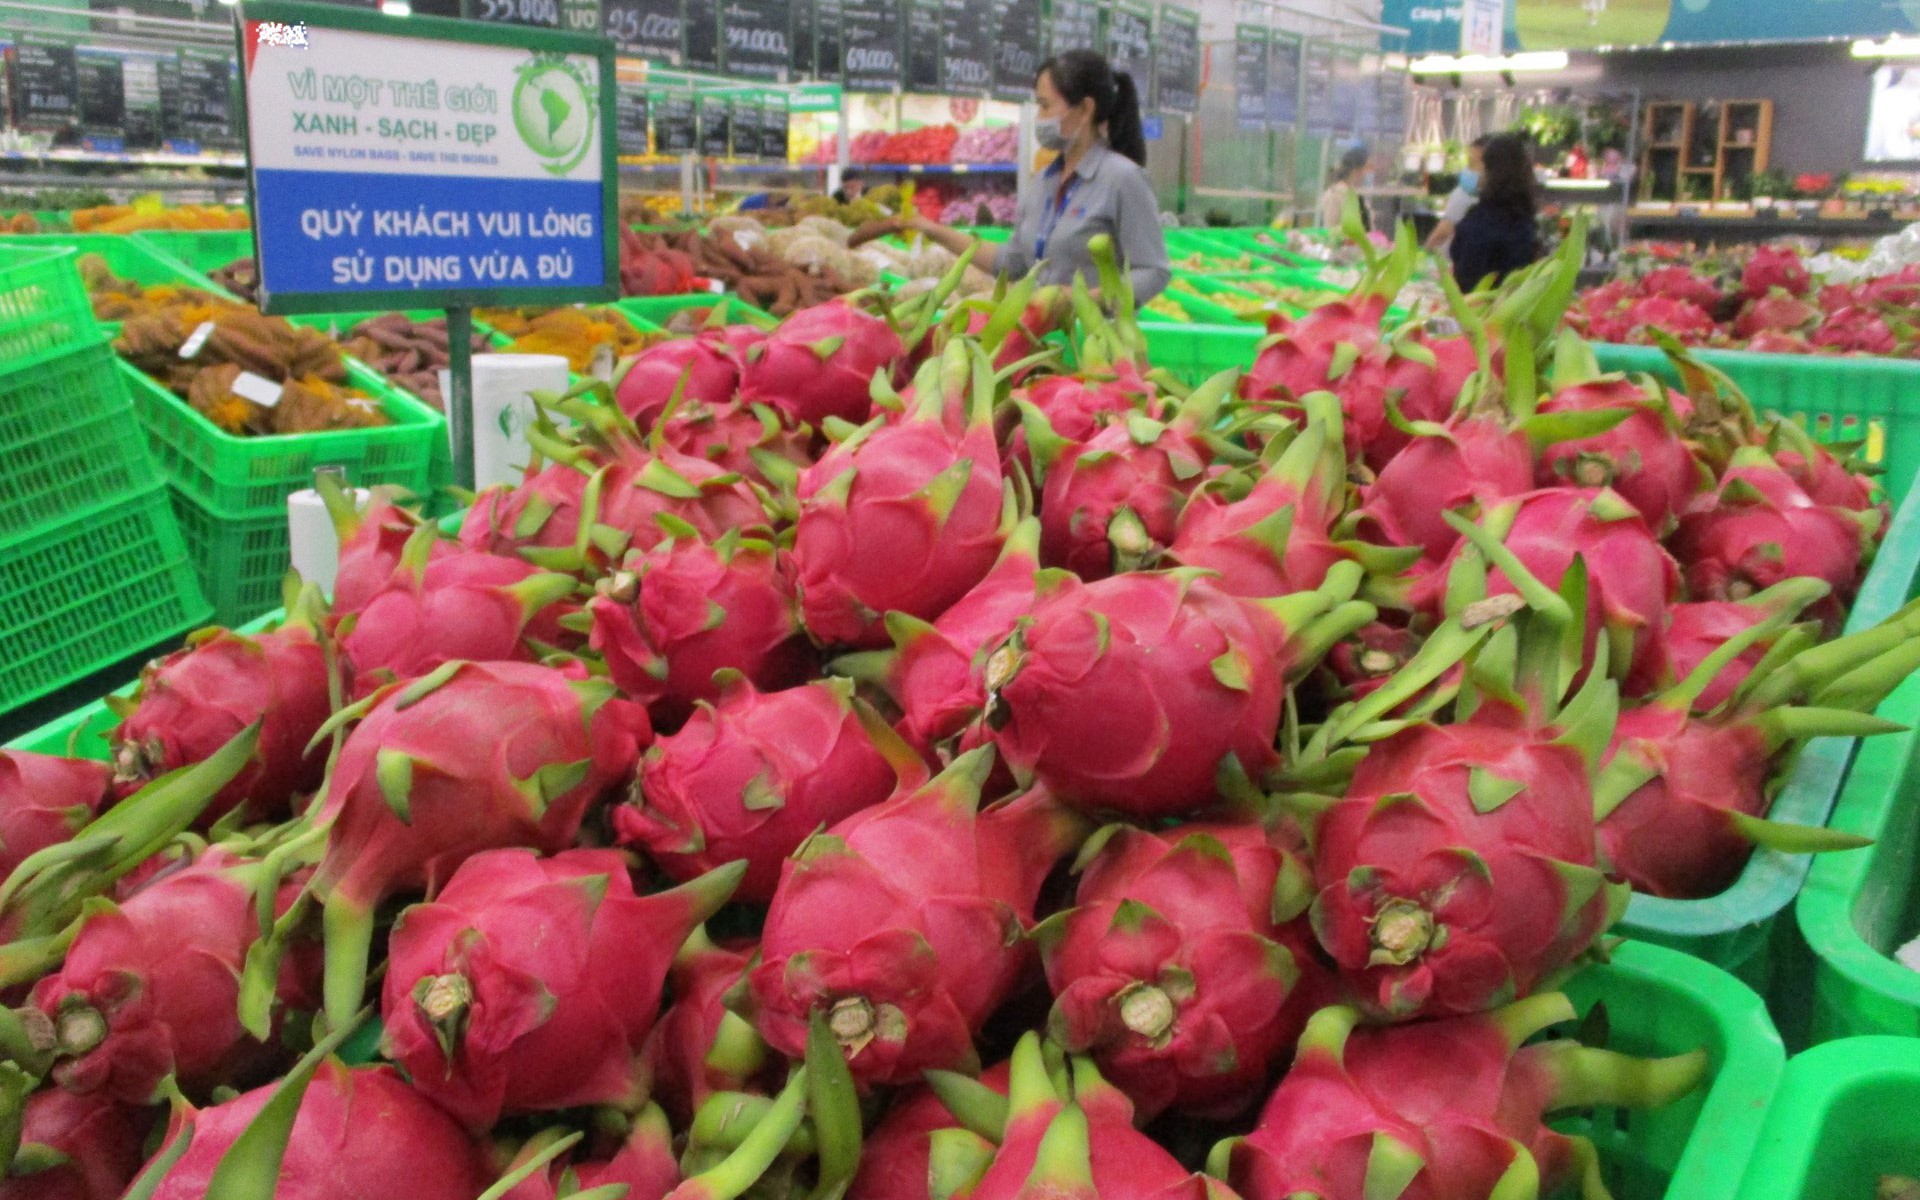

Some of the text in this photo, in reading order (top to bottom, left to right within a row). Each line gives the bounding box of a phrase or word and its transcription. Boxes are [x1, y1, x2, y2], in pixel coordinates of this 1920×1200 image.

[322, 74, 384, 110] MỘT
[292, 112, 358, 135] XANH
[378, 117, 437, 143] SẠCH
[456, 122, 498, 147] ĐẸP
[294, 145, 325, 157] SAVE
[327, 147, 366, 159] NYLON
[409, 151, 436, 162] SAVE
[440, 152, 459, 163] THE
[461, 153, 498, 165] WORLD
[373, 204, 470, 237] KHÁCH
[477, 212, 522, 237] VUI
[528, 207, 593, 237] LÒNG
[332, 248, 374, 284] SỬ
[384, 255, 461, 289] DỤNG
